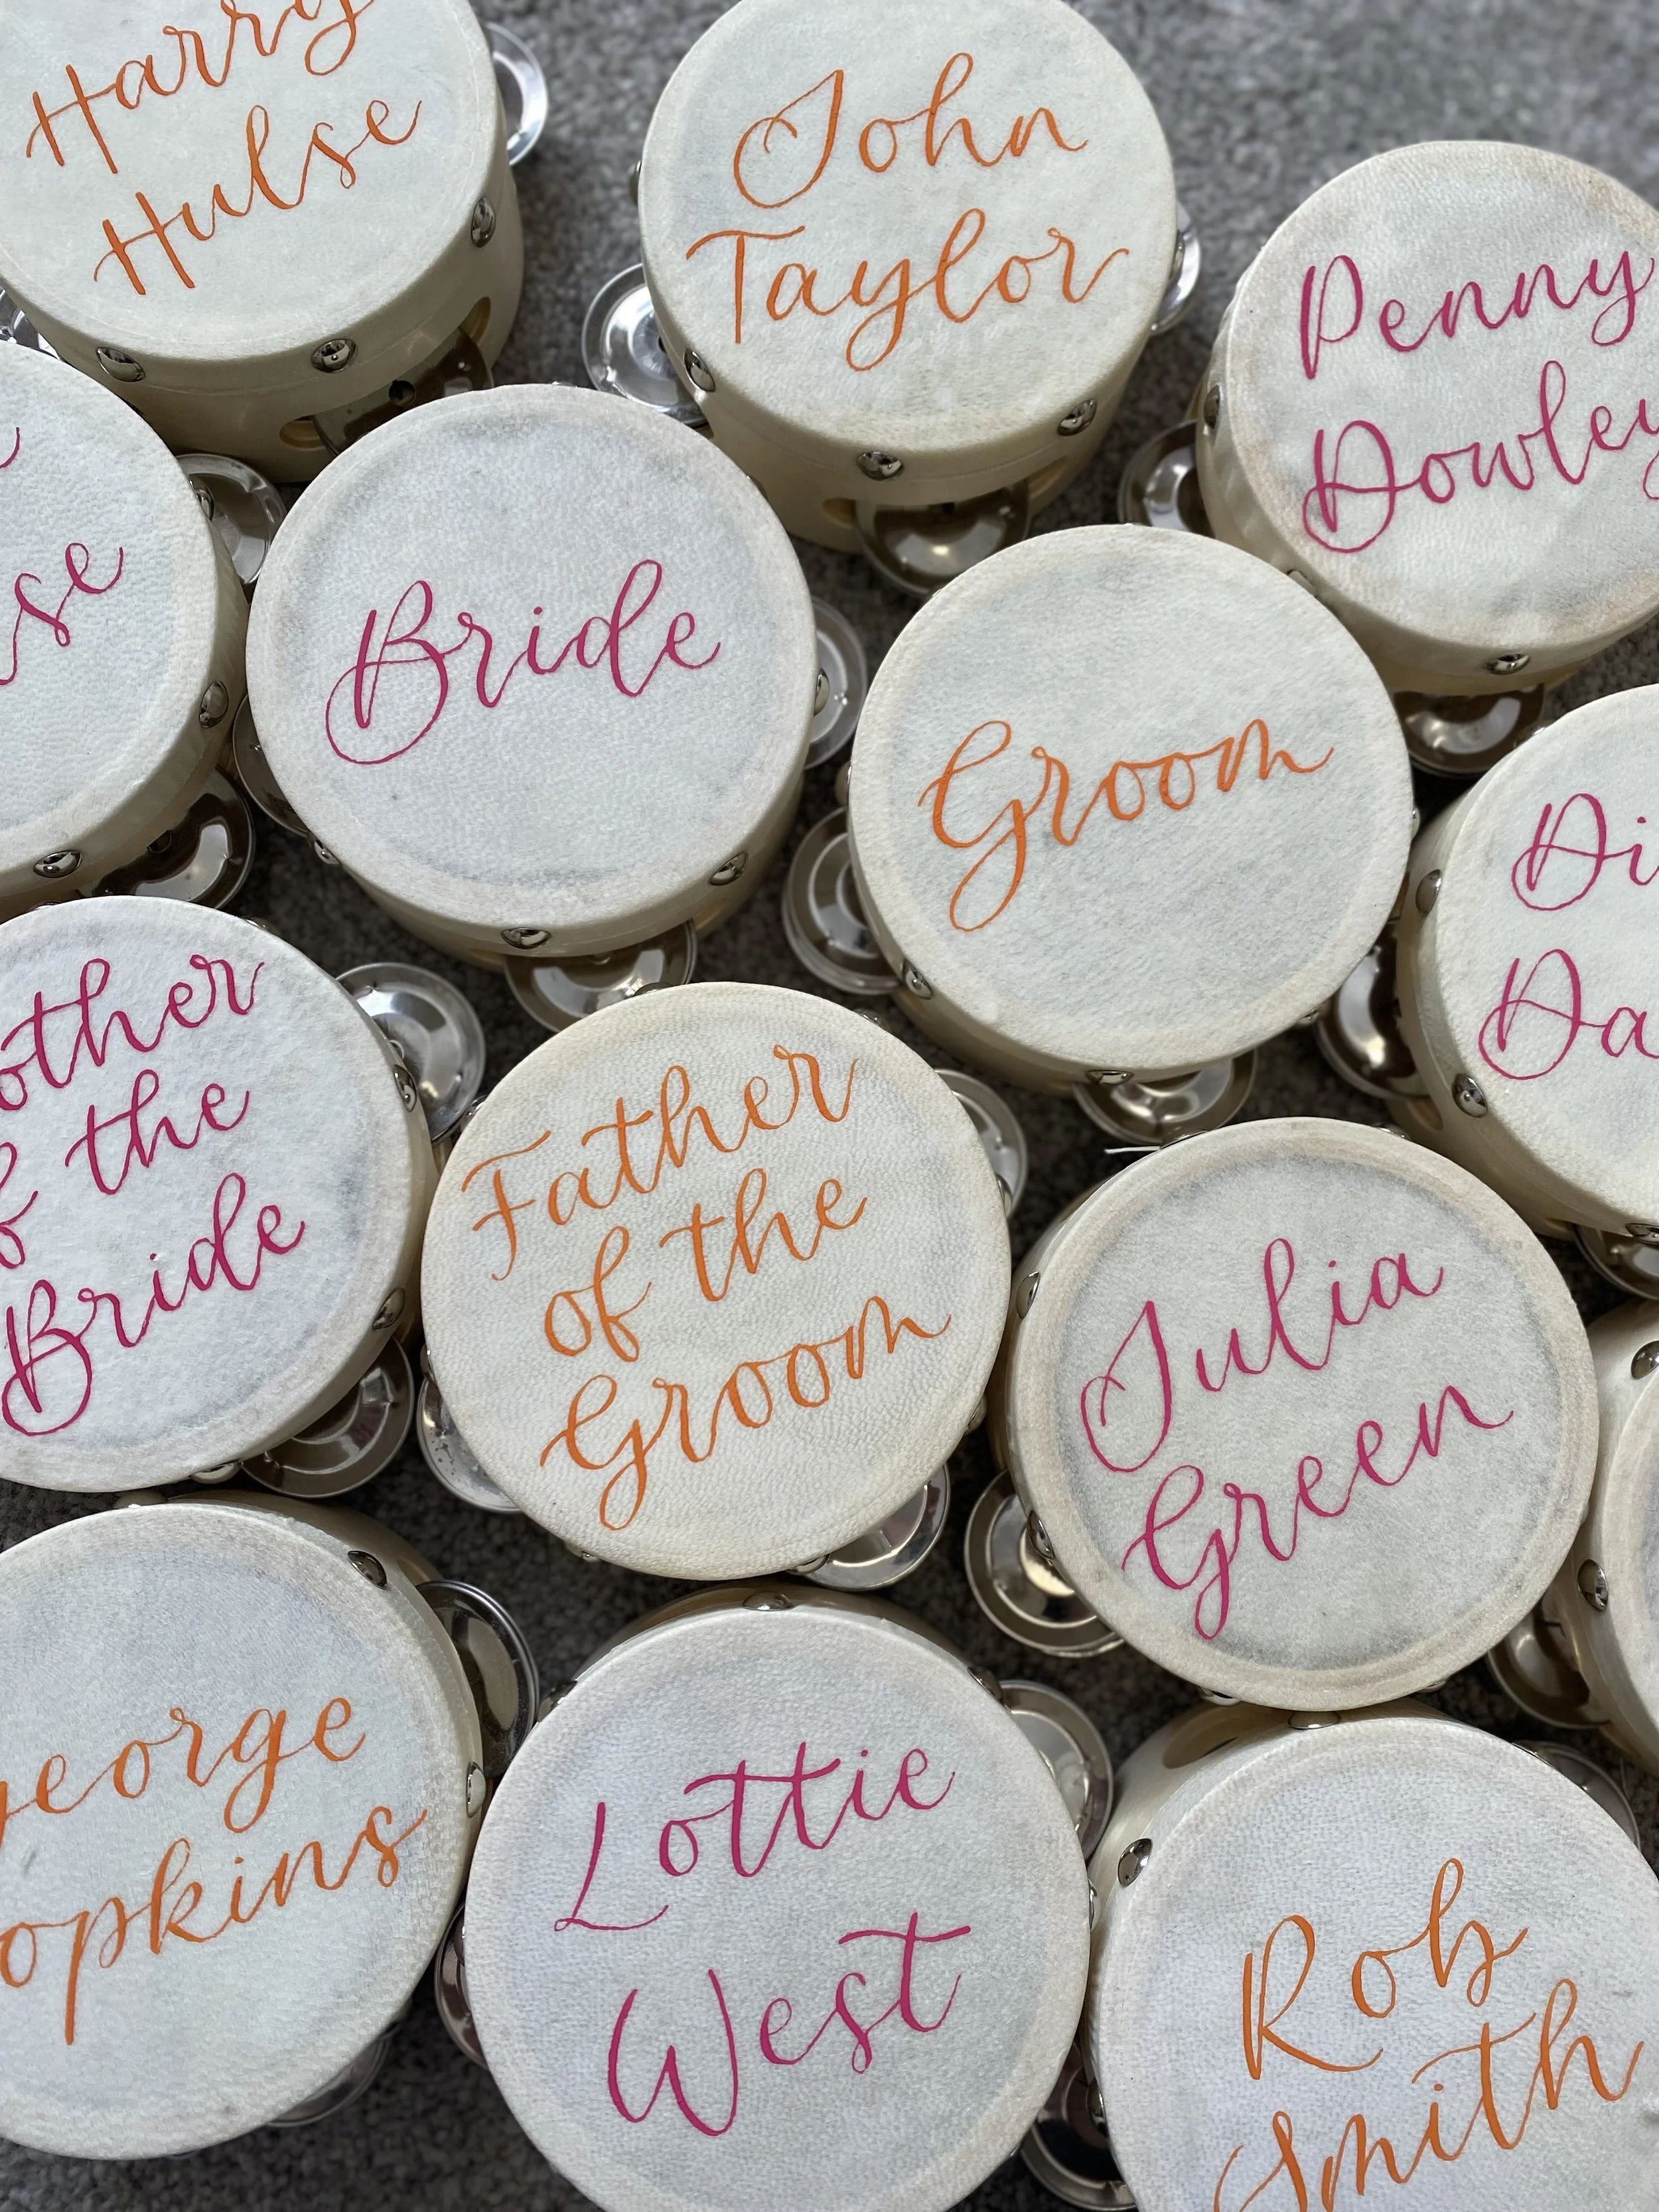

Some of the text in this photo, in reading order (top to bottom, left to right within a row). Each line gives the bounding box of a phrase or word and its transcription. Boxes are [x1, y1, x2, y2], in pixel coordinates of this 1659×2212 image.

[27, 0, 374, 174] Harry
[733, 52, 1089, 209] John
[94, 99, 423, 295] Hulse
[685, 208, 1129, 371] Taylor
[1300, 251, 1656, 380] Penny
[0, 542, 124, 686] se
[325, 559, 722, 765] Bride
[918, 718, 1334, 932] Groom
[65, 1069, 250, 1195] the
[461, 1044, 859, 1282] Father
[1, 1173, 306, 1437] Bride
[543, 1168, 869, 1363] of the
[1081, 1238, 1444, 1473] Julia
[540, 1296, 953, 1531] Groom
[1121, 1386, 1514, 1641] Green
[0, 1697, 366, 1852] eorge
[554, 1741, 956, 1933] Lottie
[607, 1911, 972, 2138] West
[1242, 1858, 1528, 2081] Rob
